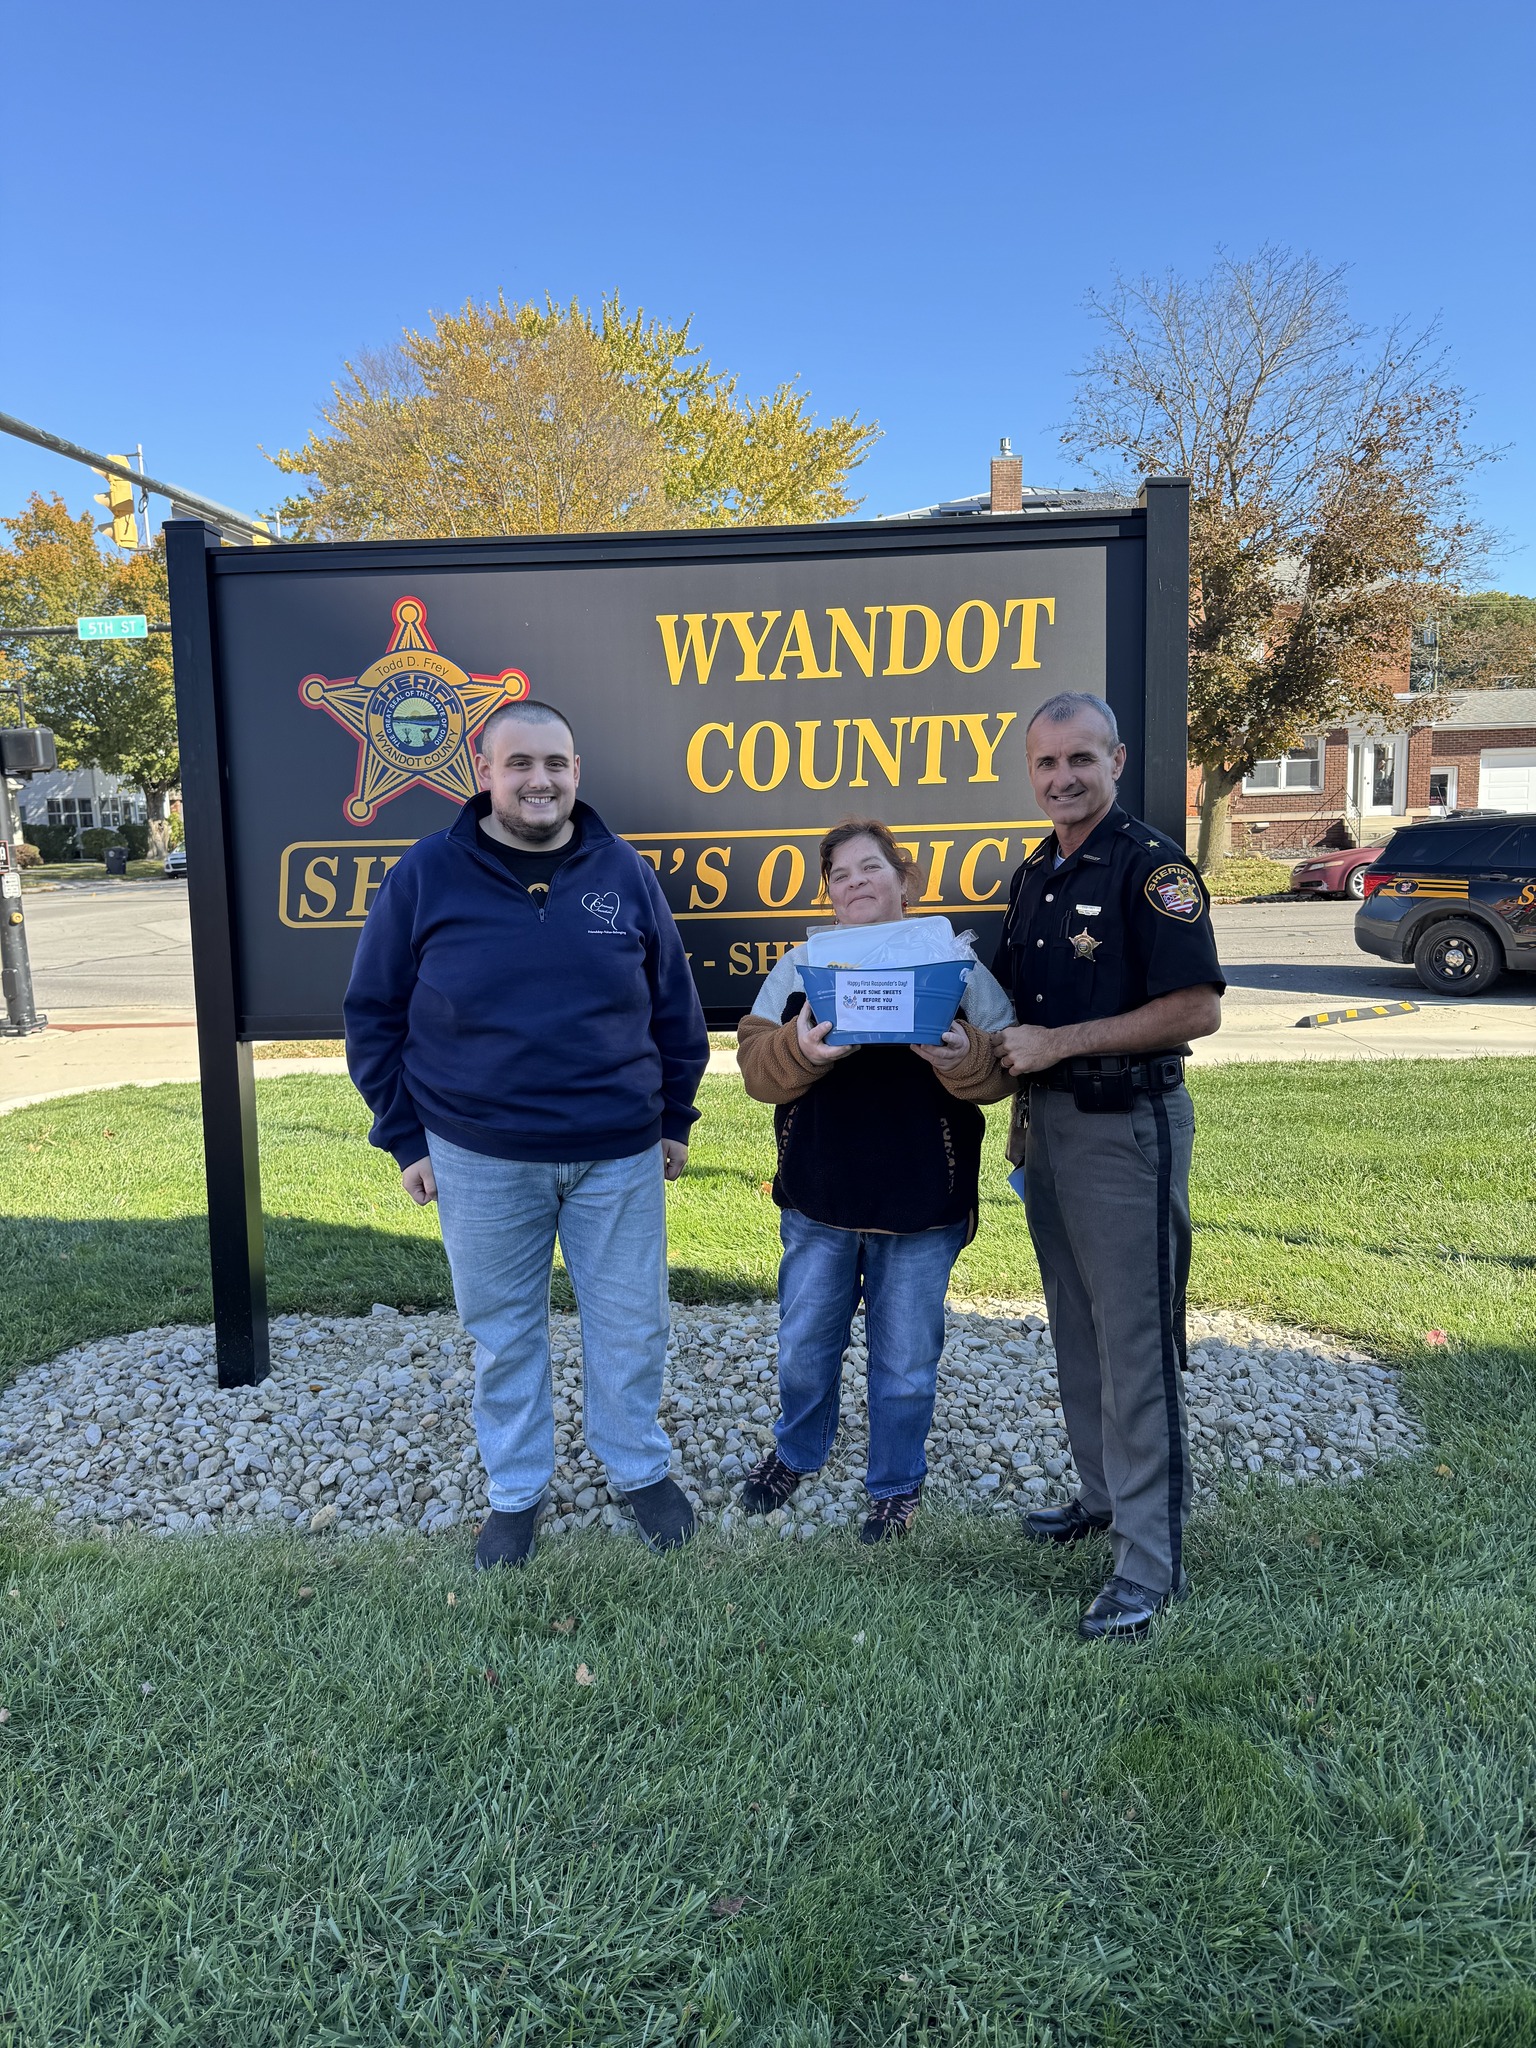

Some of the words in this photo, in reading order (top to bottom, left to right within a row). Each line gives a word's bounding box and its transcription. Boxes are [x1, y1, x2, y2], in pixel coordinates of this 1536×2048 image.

[88, 621, 114, 635] 5TH
[121, 620, 136, 634] ST
[656, 597, 1056, 686] WYANDOT
[375, 658, 403, 676] Todd
[407, 656, 419, 667] D.
[424, 657, 449, 676] Frey
[371, 675, 460, 716] SHERIFF
[390, 694, 404, 709] SEAL
[416, 690, 430, 699] THE
[430, 695, 446, 717] STATE
[385, 709, 393, 733] GREAT
[441, 718, 447, 728] OF
[375, 730, 422, 767] WYANDOT
[424, 728, 459, 767] COUNTY
[390, 734, 401, 747] THE
[434, 729, 446, 746] OHIO
[686, 712, 1017, 793] COUNTY
[1148, 867, 1194, 892] SHERIFF
